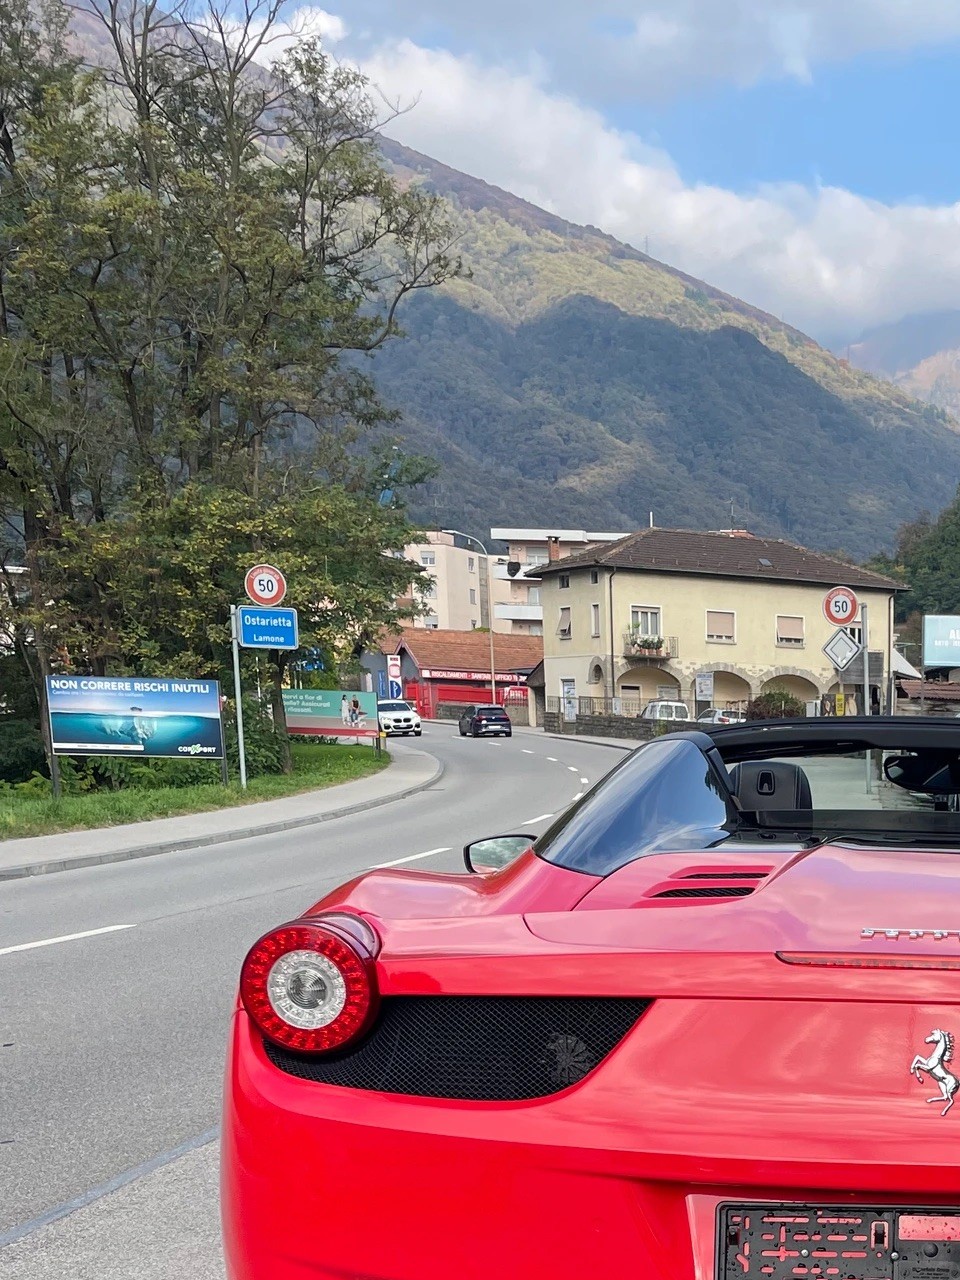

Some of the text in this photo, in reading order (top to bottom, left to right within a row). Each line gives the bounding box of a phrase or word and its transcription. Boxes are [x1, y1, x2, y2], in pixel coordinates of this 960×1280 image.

[258, 579, 274, 592] 50
[834, 600, 848, 613] 50
[244, 615, 292, 627] Ostarietta
[253, 634, 285, 643] Lamone
[50, 679, 210, 694] NON CORRERE RISCHI INUTILI
